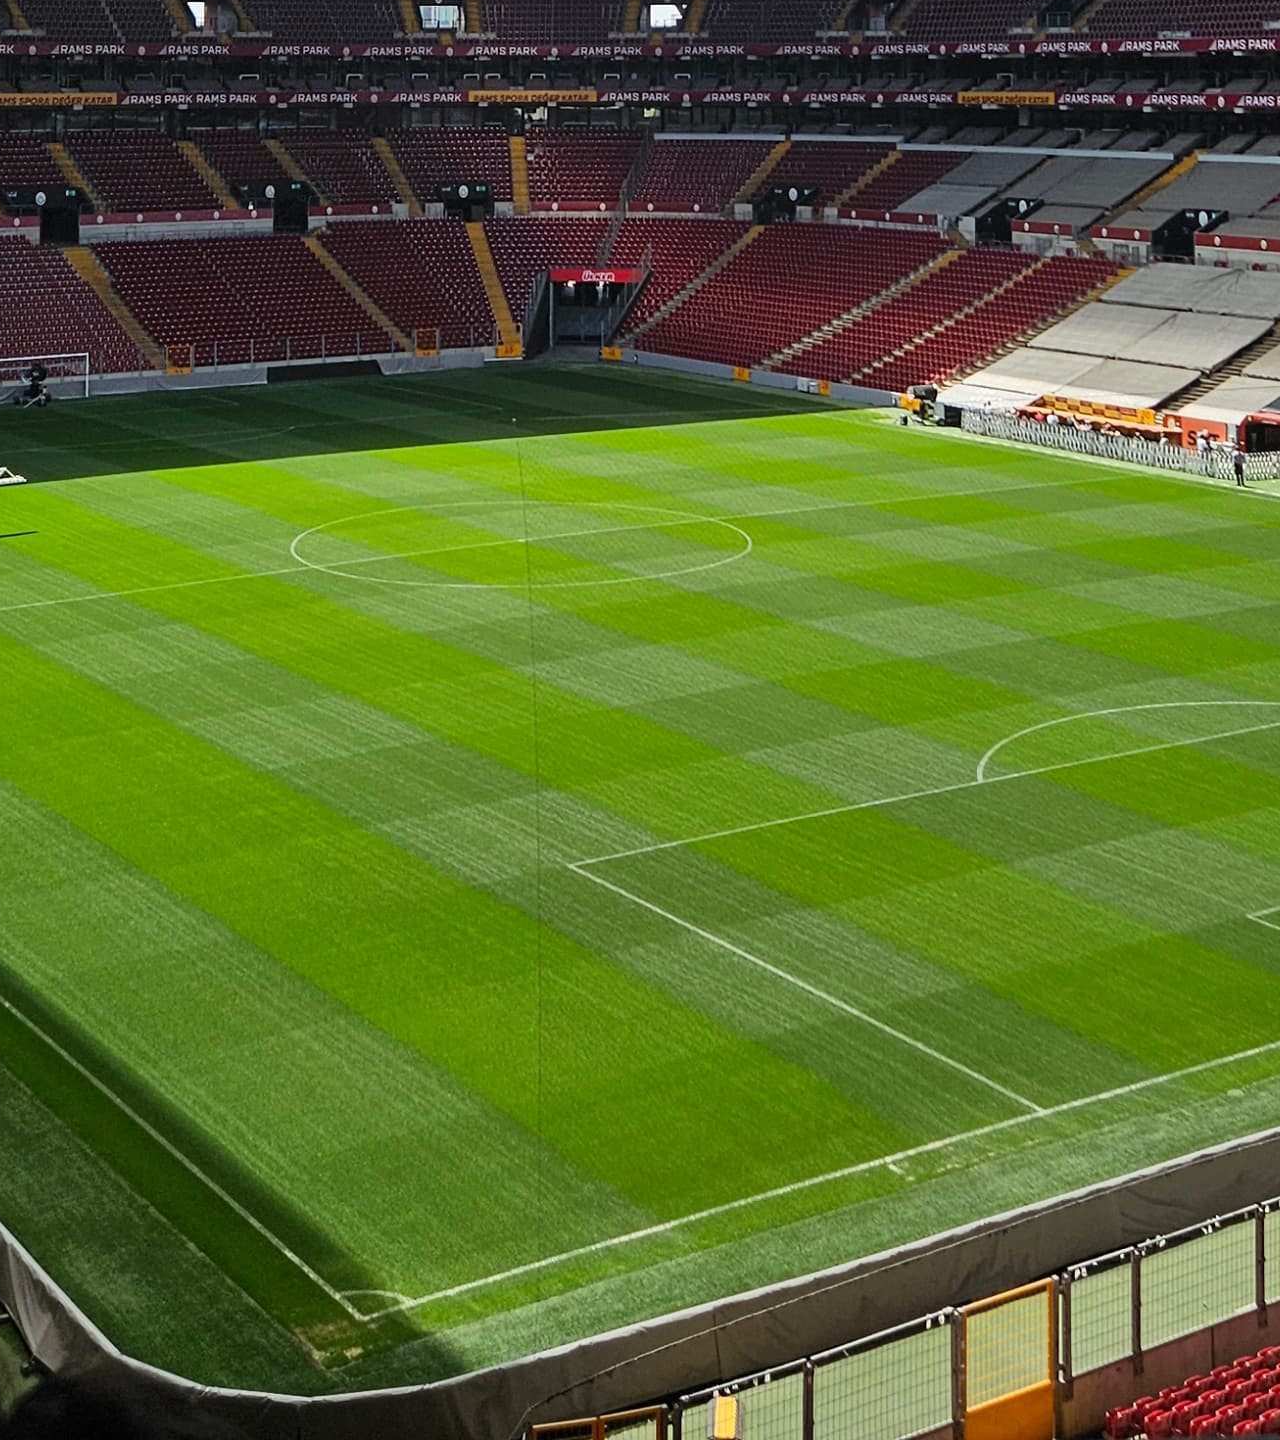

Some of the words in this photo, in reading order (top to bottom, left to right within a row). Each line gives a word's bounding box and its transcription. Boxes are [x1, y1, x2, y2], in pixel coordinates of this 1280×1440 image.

[878, 45, 902, 54] RAMS
[906, 44, 930, 54] PARK
[962, 43, 986, 53] RAMS
[988, 43, 1010, 53] PARK
[1041, 42, 1066, 52] RAMS
[1069, 42, 1091, 52] PARK
[1126, 41, 1152, 52] RAMS
[1154, 41, 1180, 51] PARK
[1218, 39, 1244, 50] RAMS
[1248, 39, 1276, 50] PARK
[60, 45, 92, 55] RAMS
[96, 45, 124, 55] PARK
[168, 45, 198, 55] RAMS
[202, 46, 229, 55] PARK
[270, 46, 300, 55] RAMS
[303, 46, 330, 55] PARK
[372, 47, 402, 56] RAMS
[405, 46, 433, 56] PARK
[476, 46, 506, 56] RAMS
[510, 46, 538, 56] PARK
[580, 46, 612, 56] RAMS
[615, 46, 641, 55] PARK
[684, 46, 713, 55] RAMS
[716, 46, 744, 55] PARK
[784, 46, 811, 55] RAMS
[814, 46, 840, 55] PARK
[131, 96, 162, 104] RAMS
[164, 95, 192, 104] PARK
[196, 94, 226, 104] RAMS
[229, 94, 256, 103] PARK
[298, 94, 326, 103] RAMS
[330, 94, 358, 103] PARK
[400, 93, 430, 102] RAMS
[434, 94, 462, 102] PARK
[610, 92, 639, 102] RAMS
[642, 93, 670, 102] PARK
[712, 93, 740, 102] RAMS
[744, 93, 771, 102] PARK
[810, 94, 838, 102] RAMS
[841, 94, 866, 103] PARK
[902, 94, 926, 103] RAMS
[929, 94, 952, 103] PARK
[1065, 94, 1088, 104] RAMS
[1092, 94, 1116, 104] PARK
[1152, 95, 1178, 105] RAMS
[1181, 95, 1206, 106] PARK
[1246, 96, 1274, 107] RAMS
